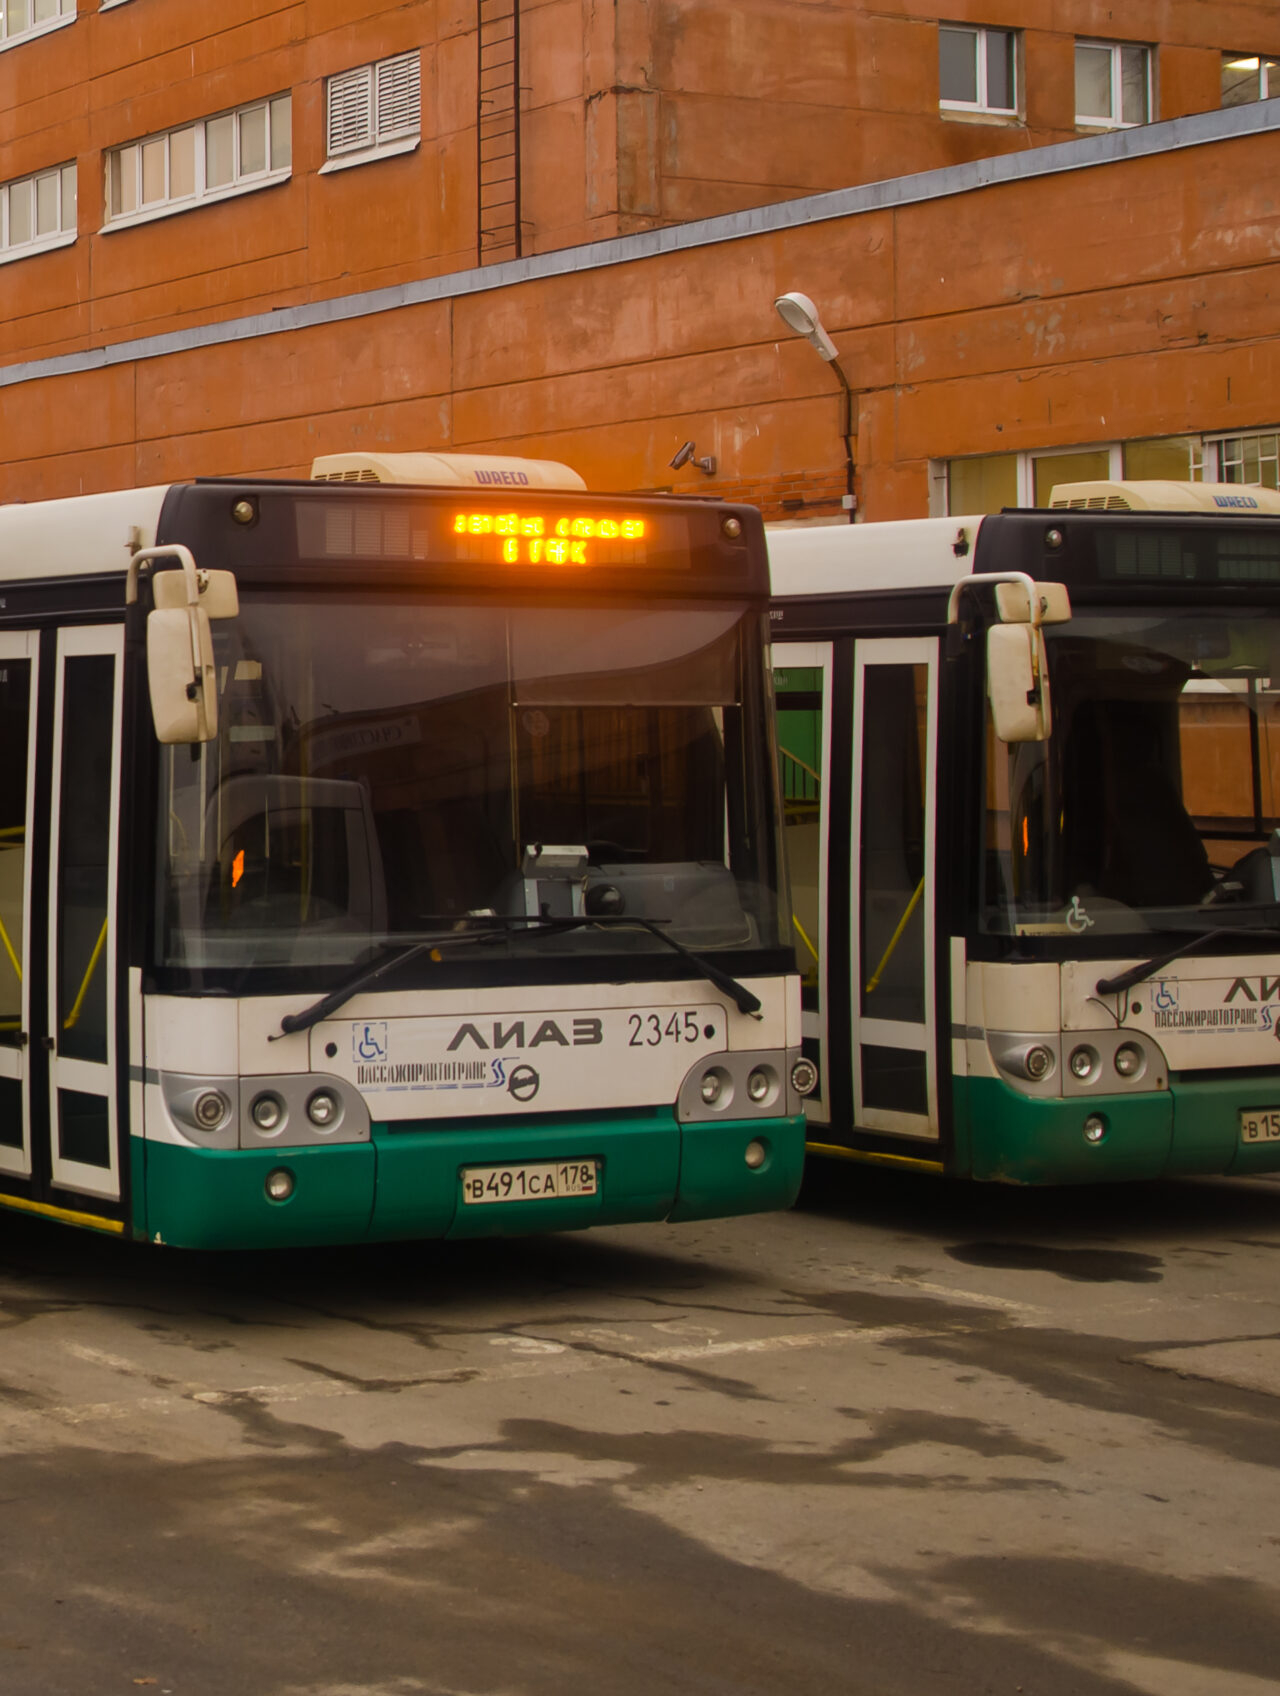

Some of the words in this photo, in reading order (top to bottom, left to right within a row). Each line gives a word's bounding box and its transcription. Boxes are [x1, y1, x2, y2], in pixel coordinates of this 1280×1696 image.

[474, 470, 529, 485] WAECO
[1154, 1007, 1258, 1028] ПАССАЖИРАВТОТРАНС
[446, 1018, 603, 1051] ЛИАЗ
[628, 1011, 699, 1047] 2345
[357, 1061, 487, 1085] ПАССАЖИРАВТОТРАНС
[560, 1164, 589, 1185] 178
